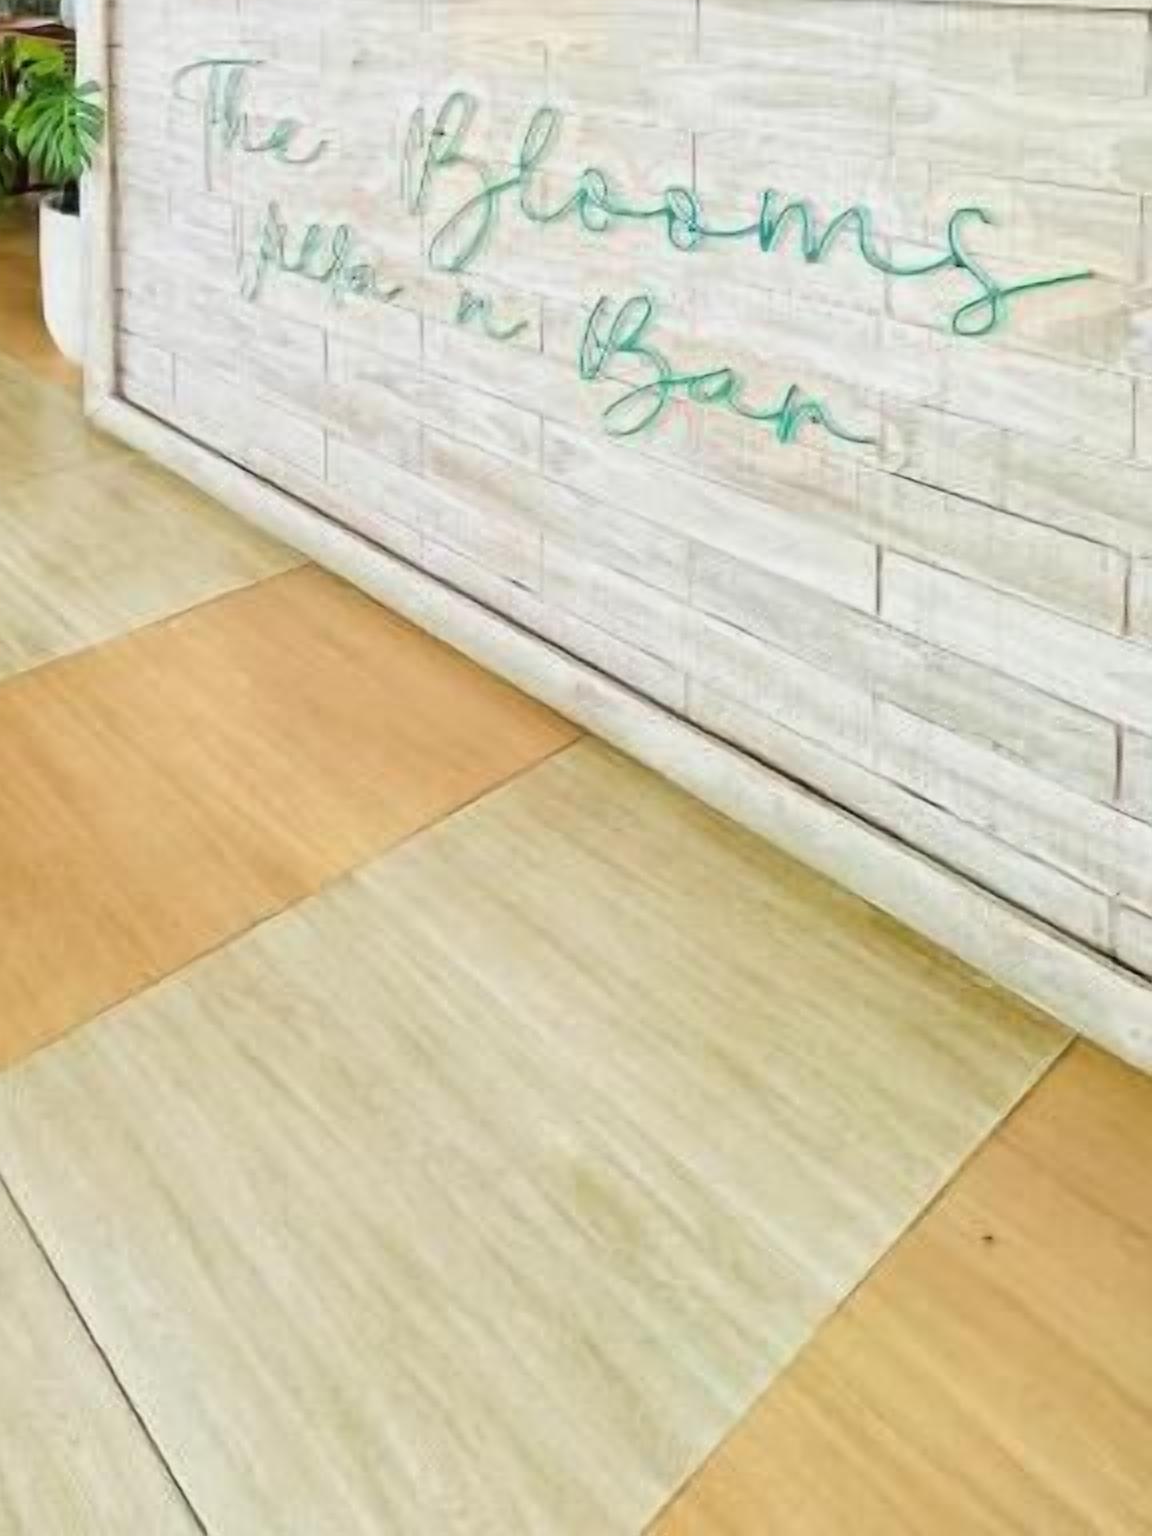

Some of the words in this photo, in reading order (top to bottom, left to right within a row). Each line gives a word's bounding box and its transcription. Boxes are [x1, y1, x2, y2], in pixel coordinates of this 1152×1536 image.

[170, 58, 329, 192] The
[401, 91, 1094, 336] Blooms
[579, 294, 877, 443] Bar
